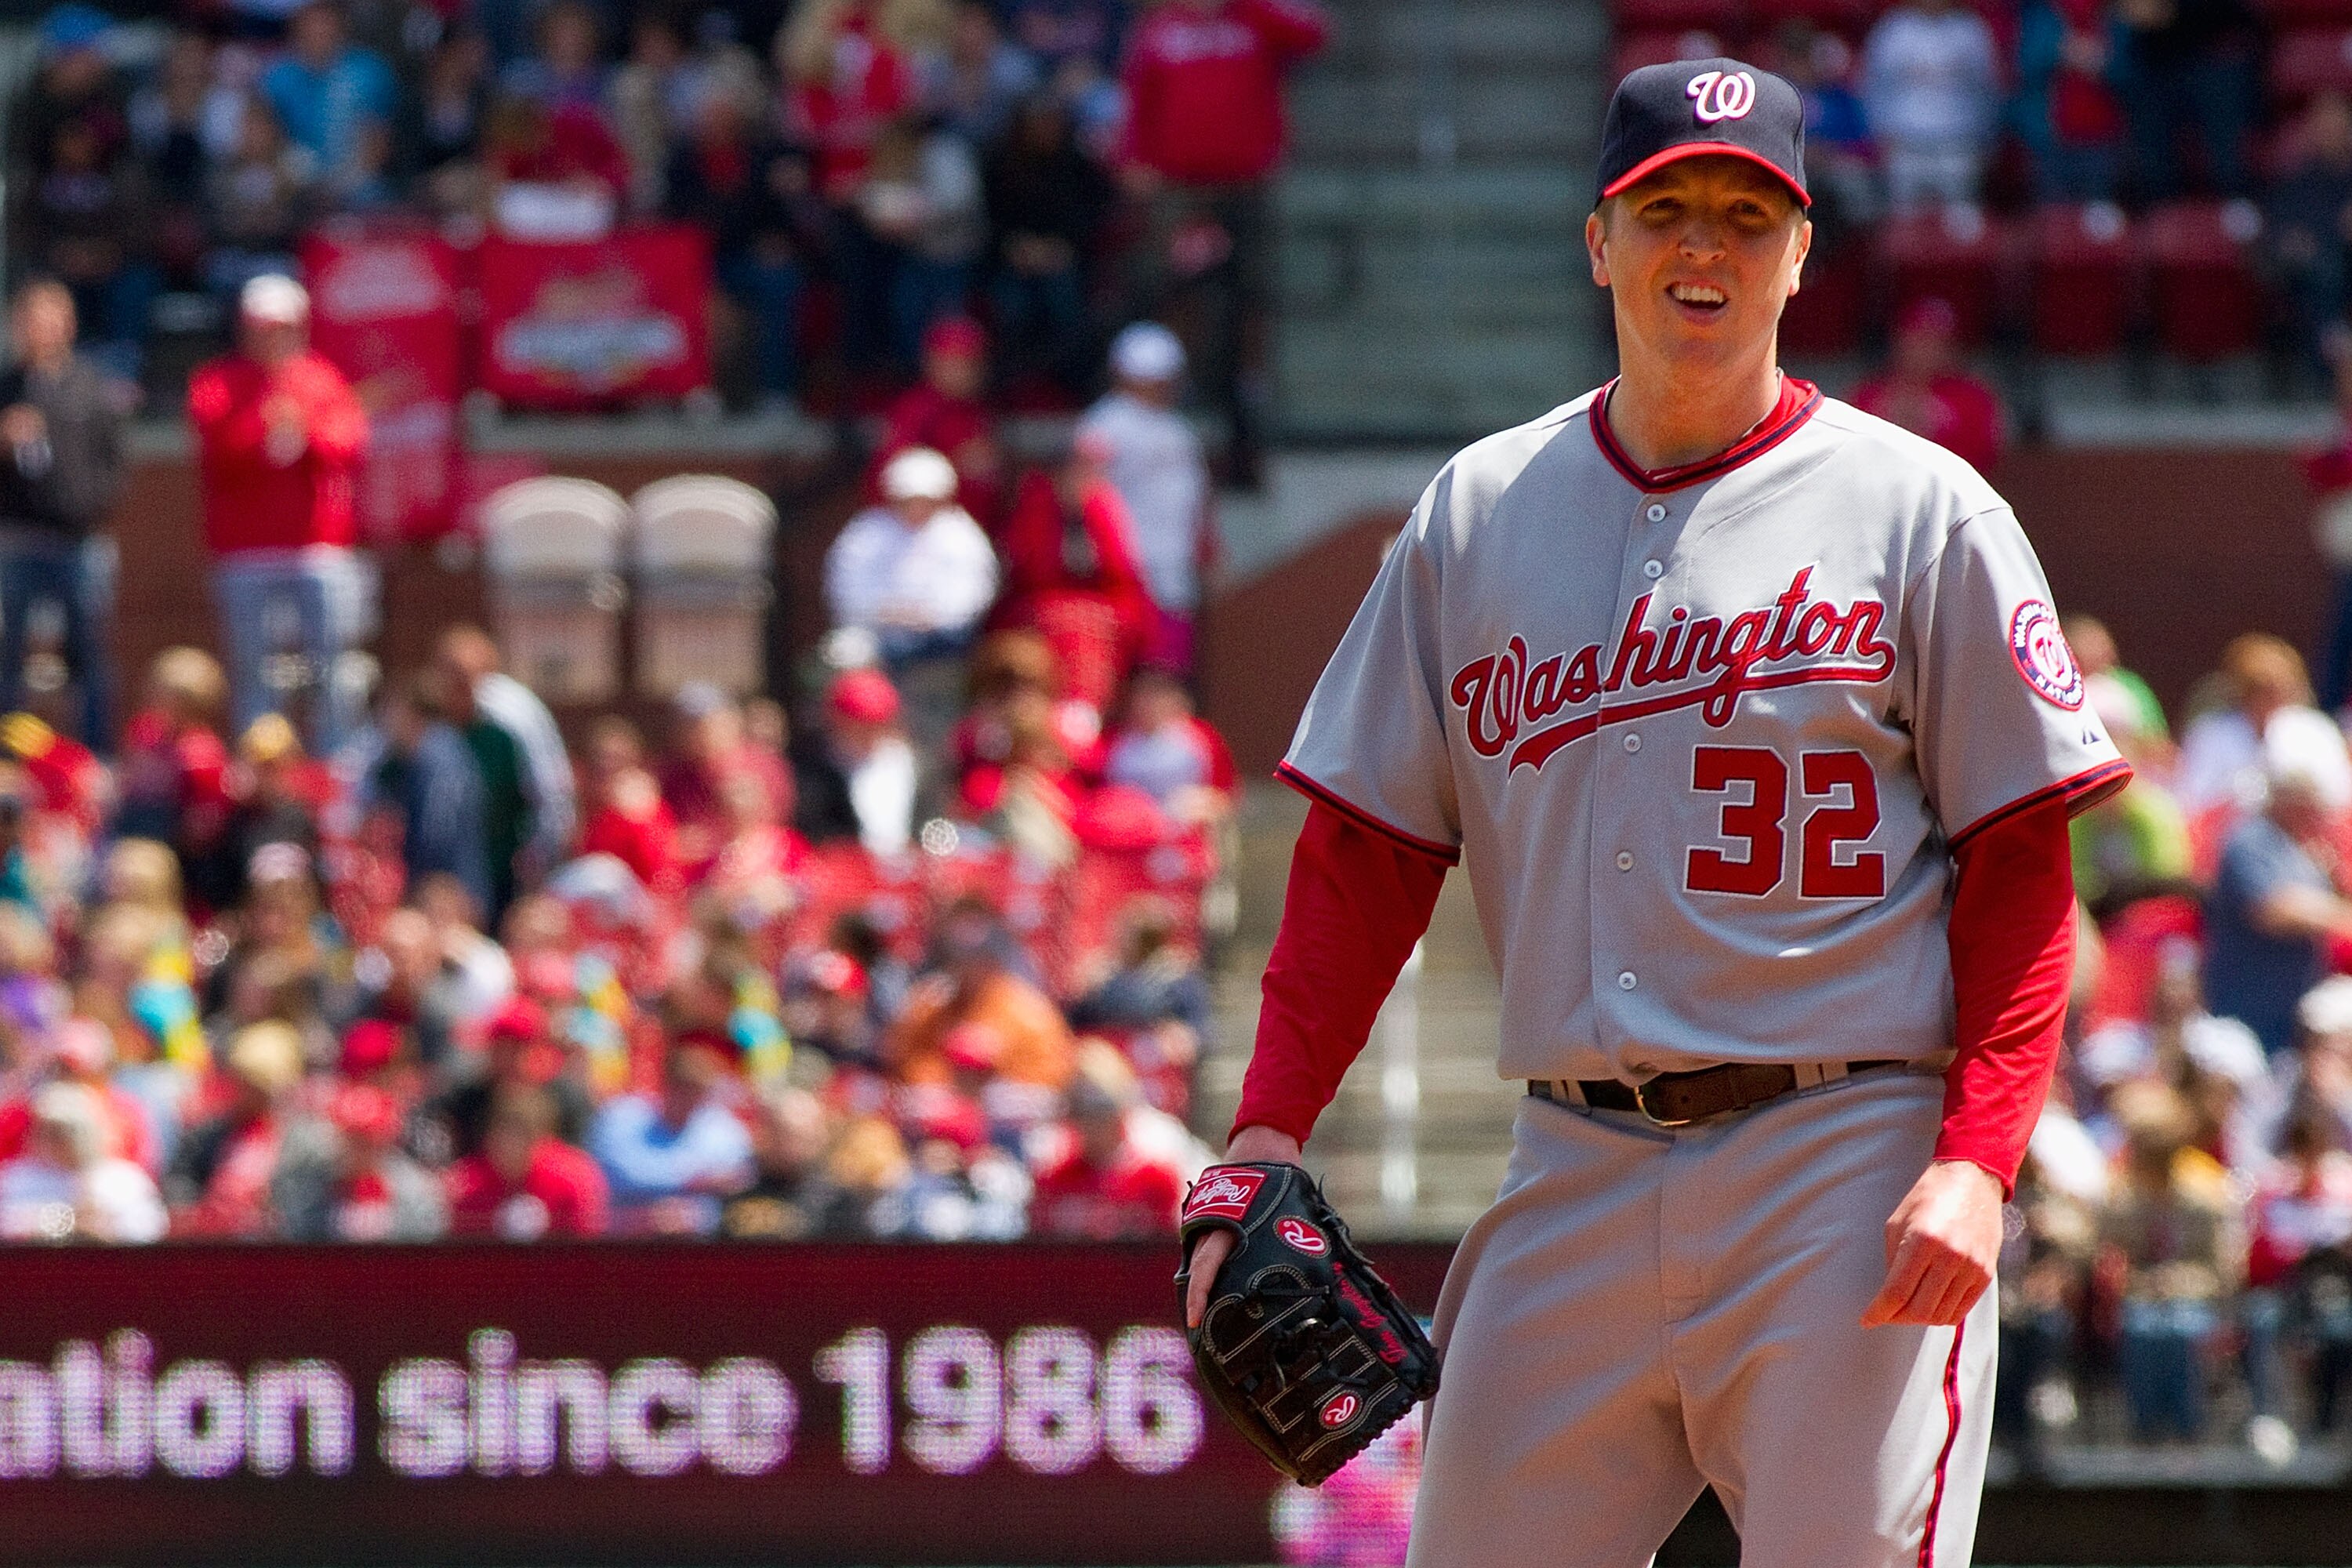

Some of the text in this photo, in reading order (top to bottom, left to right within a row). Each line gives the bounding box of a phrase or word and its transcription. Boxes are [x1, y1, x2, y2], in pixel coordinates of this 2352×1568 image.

[1686, 71, 1756, 122] W
[1450, 560, 1896, 760] Washington
[1682, 744, 1886, 900] 32
[0, 1324, 1203, 1479] ation since 1986
